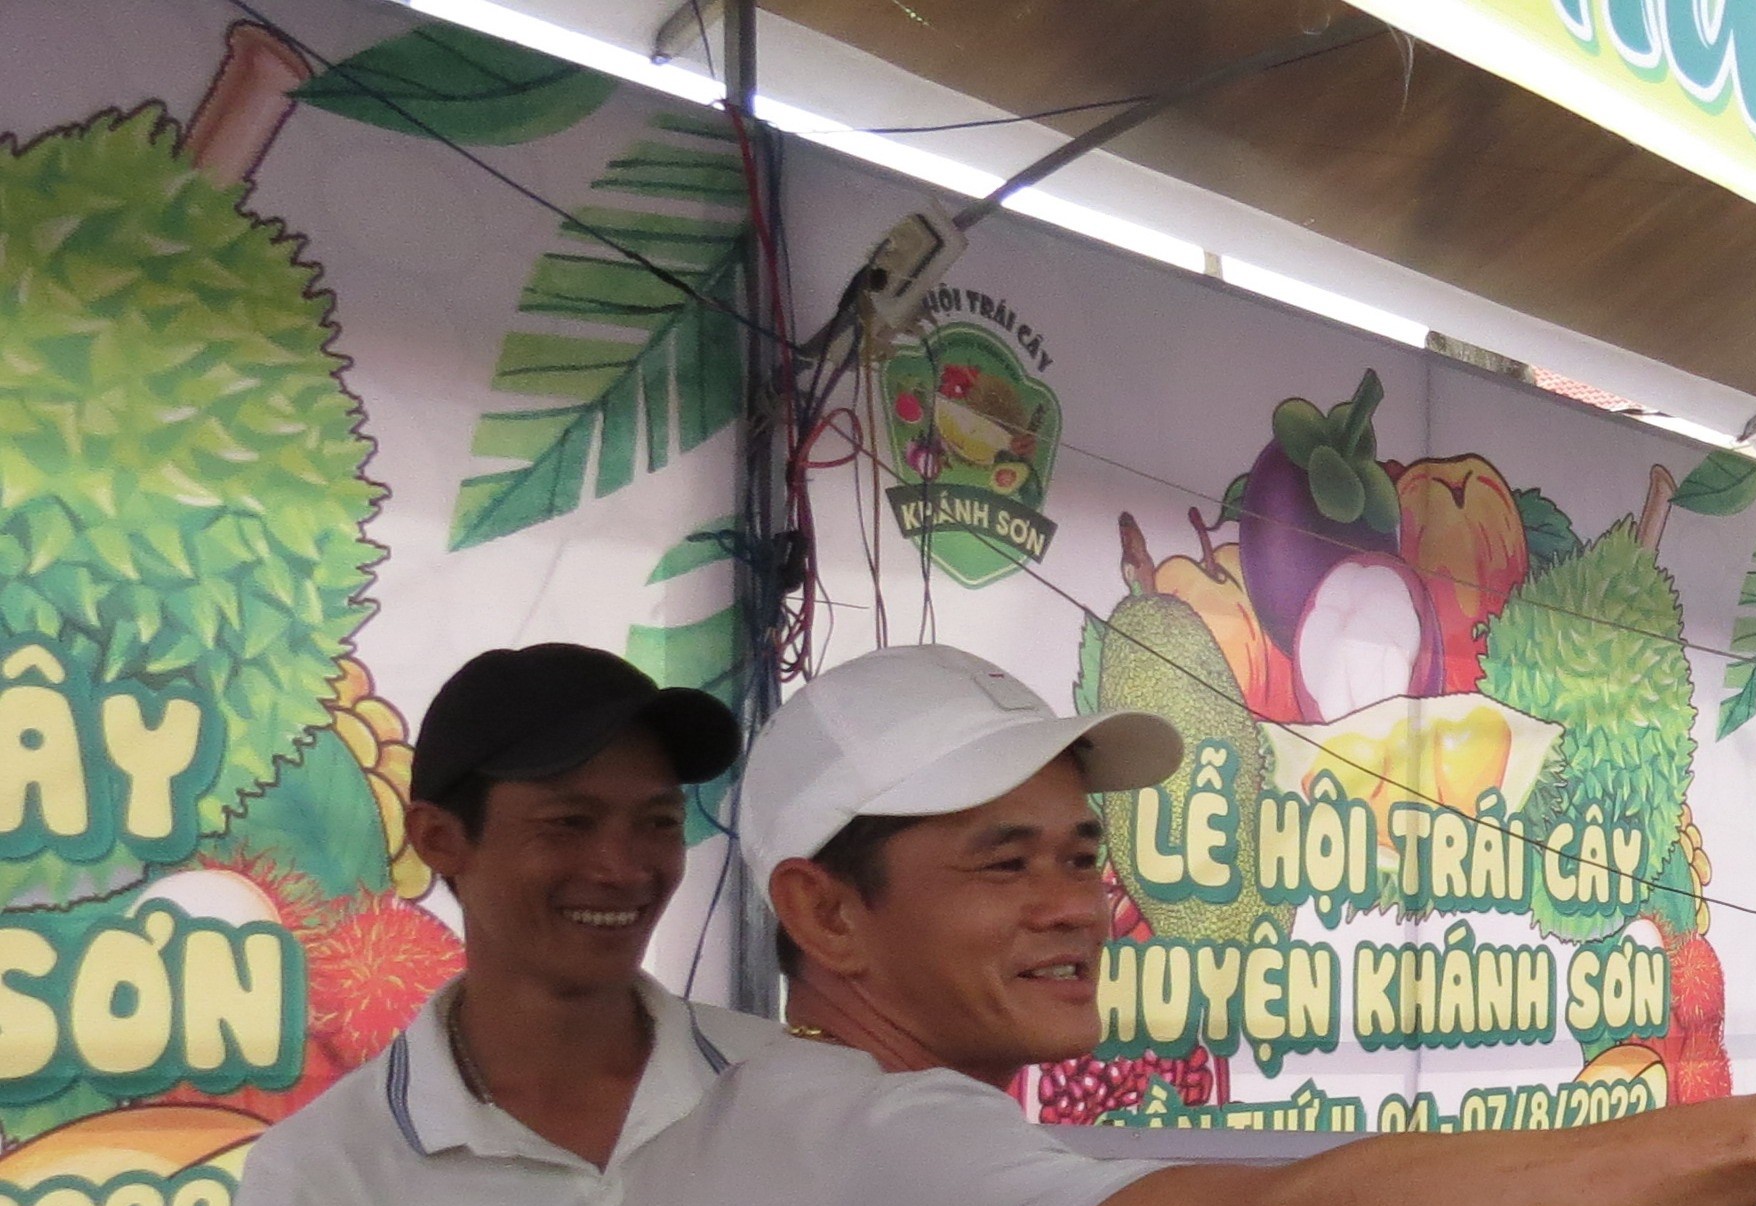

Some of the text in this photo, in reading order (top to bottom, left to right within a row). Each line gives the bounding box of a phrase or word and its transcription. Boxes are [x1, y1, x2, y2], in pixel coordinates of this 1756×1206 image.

[966, 289, 1016, 332] TRÁI
[1017, 324, 1054, 373] CÂY
[902, 492, 1045, 558] KHÁNH SƠN
[1136, 748, 1642, 912] LỄ HỘI TRÁI CÂY
[1101, 919, 1665, 1060] HUYỆN KHÁNH SƠN
